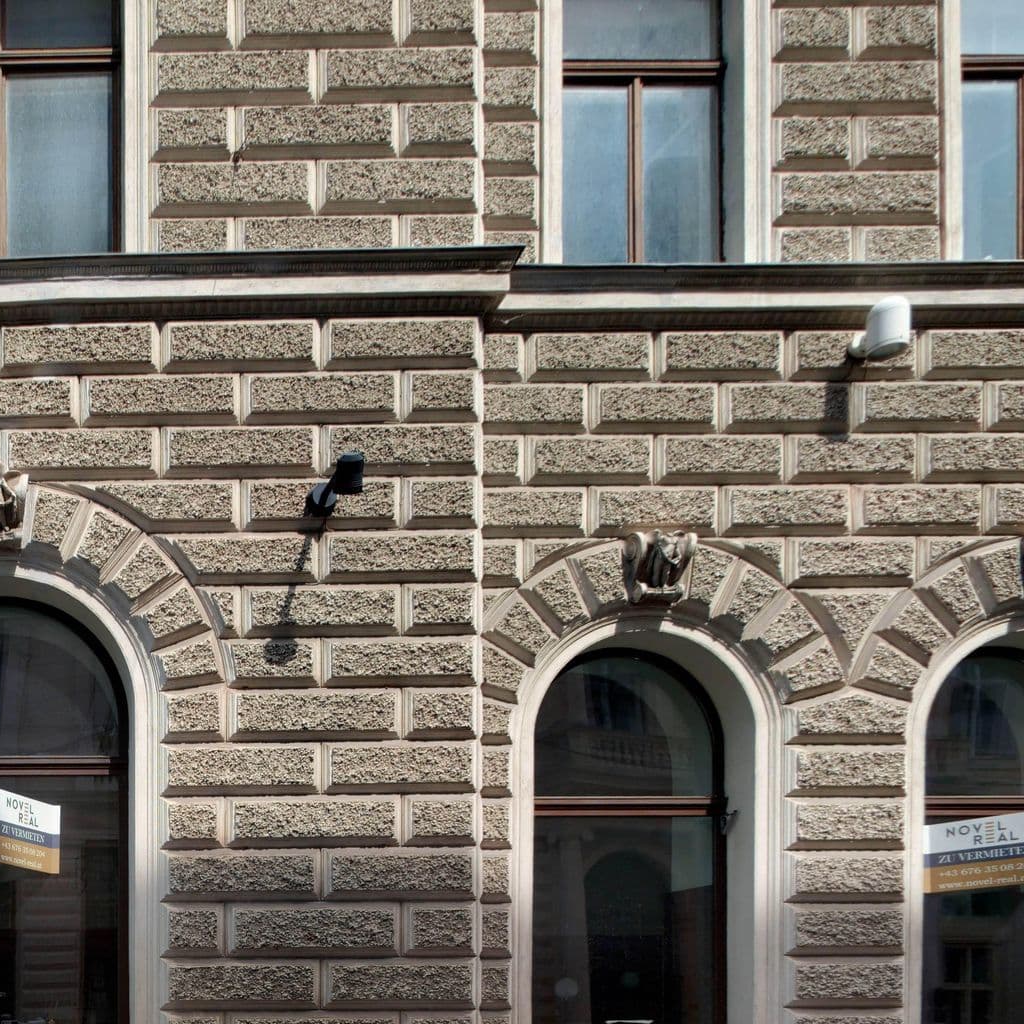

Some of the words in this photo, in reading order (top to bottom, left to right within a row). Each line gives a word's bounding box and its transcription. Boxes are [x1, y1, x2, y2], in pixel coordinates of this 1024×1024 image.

[6, 797, 34, 815] NOVEL
[19, 812, 39, 828] REAL
[945, 821, 1007, 838] NOVEL
[974, 831, 1020, 845] REAL
[938, 853, 956, 864] ZU
